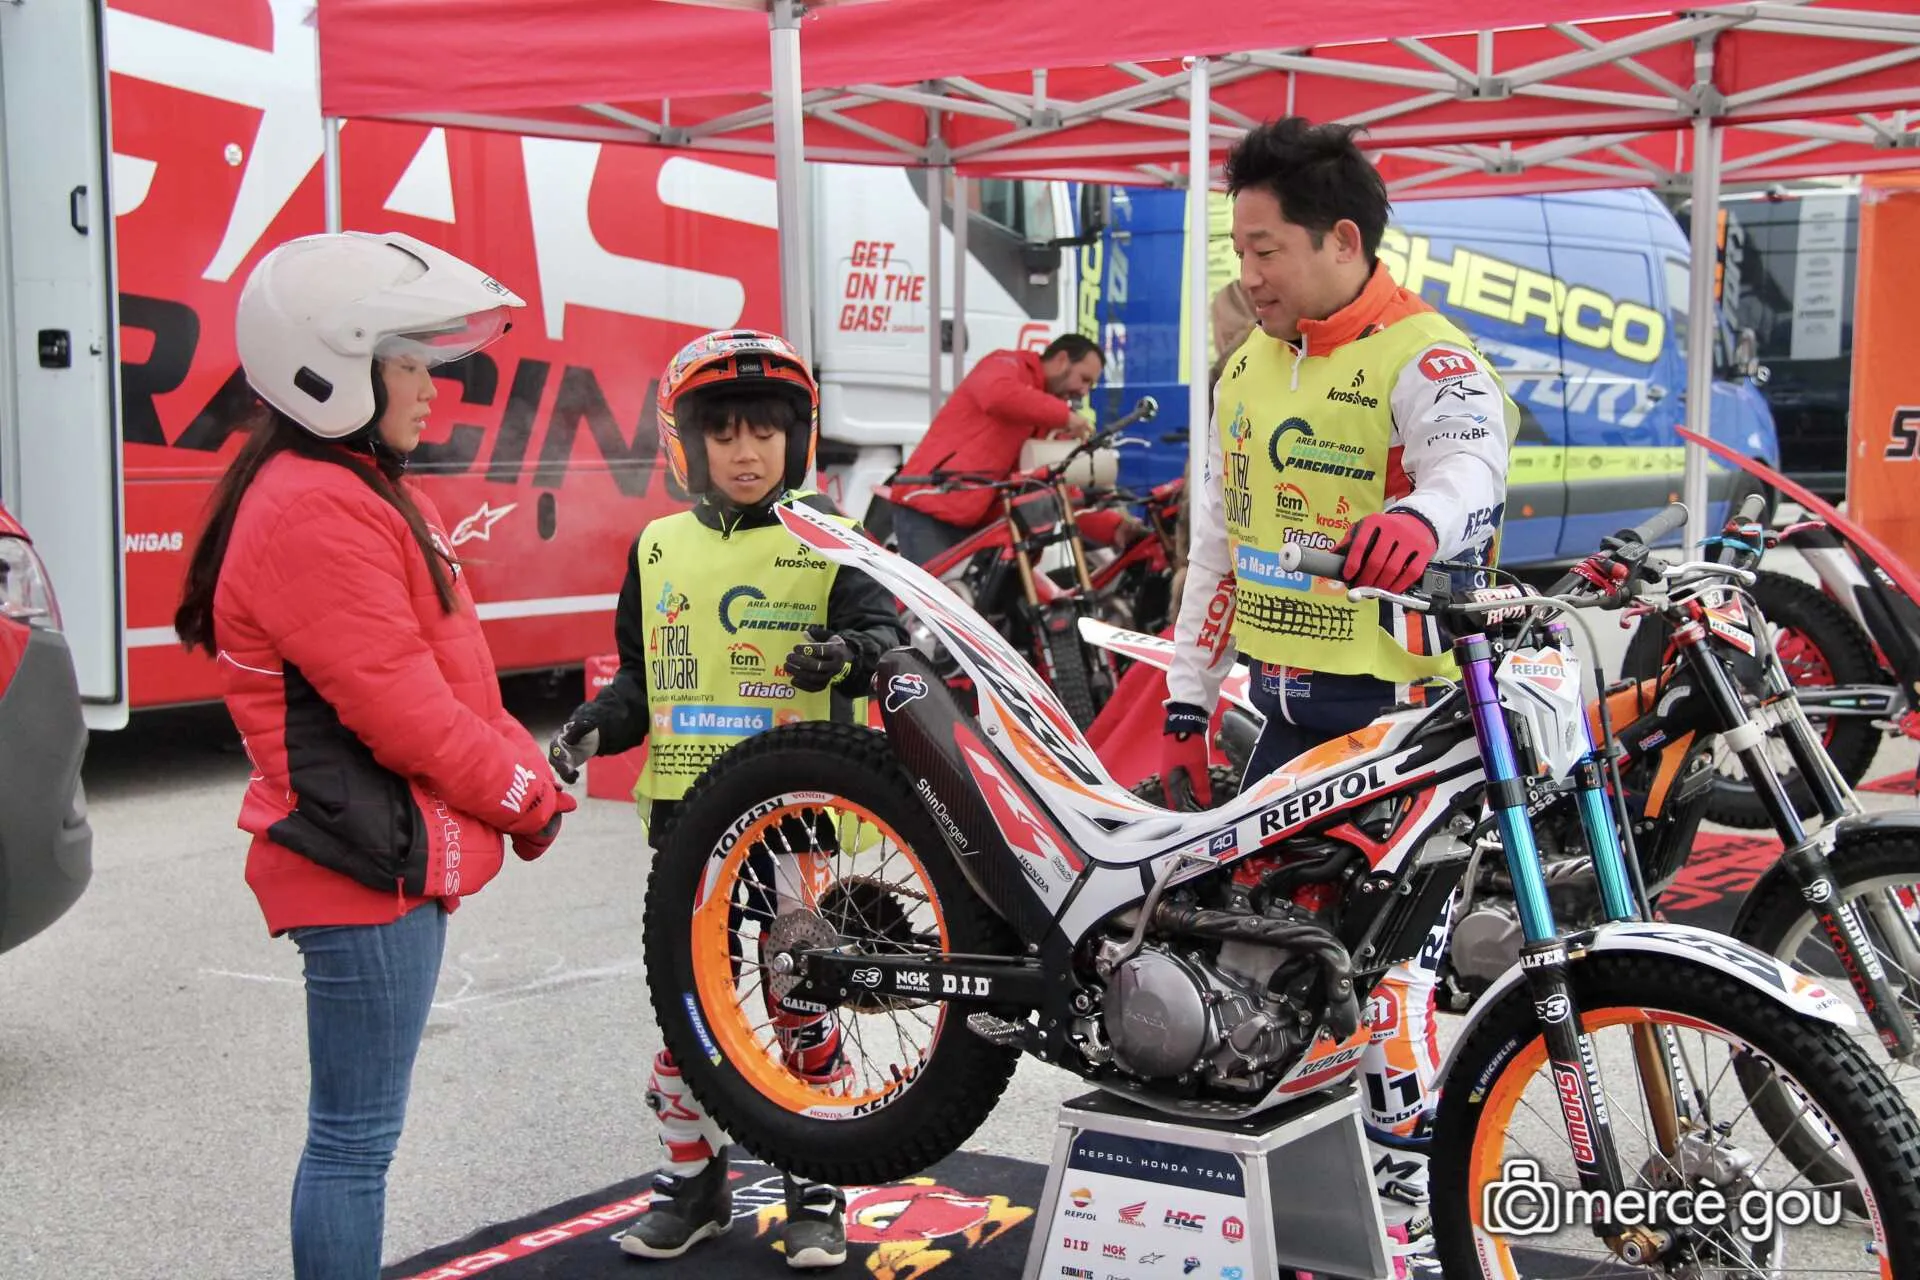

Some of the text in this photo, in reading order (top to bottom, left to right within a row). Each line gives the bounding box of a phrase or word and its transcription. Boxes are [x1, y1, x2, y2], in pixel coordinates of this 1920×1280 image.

[850, 240, 895, 268] GET
[845, 273, 925, 302] ON THE
[839, 305, 890, 332] GAS!
[1296, 436, 1365, 455] AREA OFF-ROAD
[1285, 457, 1376, 481] PARCMOTOR
[1276, 492, 1303, 511] fcm
[773, 602, 817, 611] OFF-ROAD
[730, 652, 760, 666] fcm
[1511, 662, 1567, 678] REPSOL
[739, 682, 796, 699] TrialGo
[680, 713, 695, 727] La
[698, 711, 763, 728] Marató
[1259, 765, 1386, 837] REPSOL
[916, 778, 968, 849] ShinDengen
[712, 797, 784, 860] REPSOL
[1212, 834, 1233, 850] 40
[1018, 854, 1049, 893] HONDA
[1819, 914, 1876, 1013] HONDA
[852, 968, 882, 988] S3
[896, 971, 930, 987] NGK
[783, 996, 828, 1014] GALFER
[1298, 1047, 1360, 1077] REPSOL
[1480, 1038, 1519, 1086] MICHELIN
[1370, 1103, 1424, 1125] hebo
[1079, 1149, 1236, 1182] REPSOL HONDA TEAM
[1064, 1209, 1097, 1221] REPSOL
[1103, 1244, 1127, 1257] NGK
